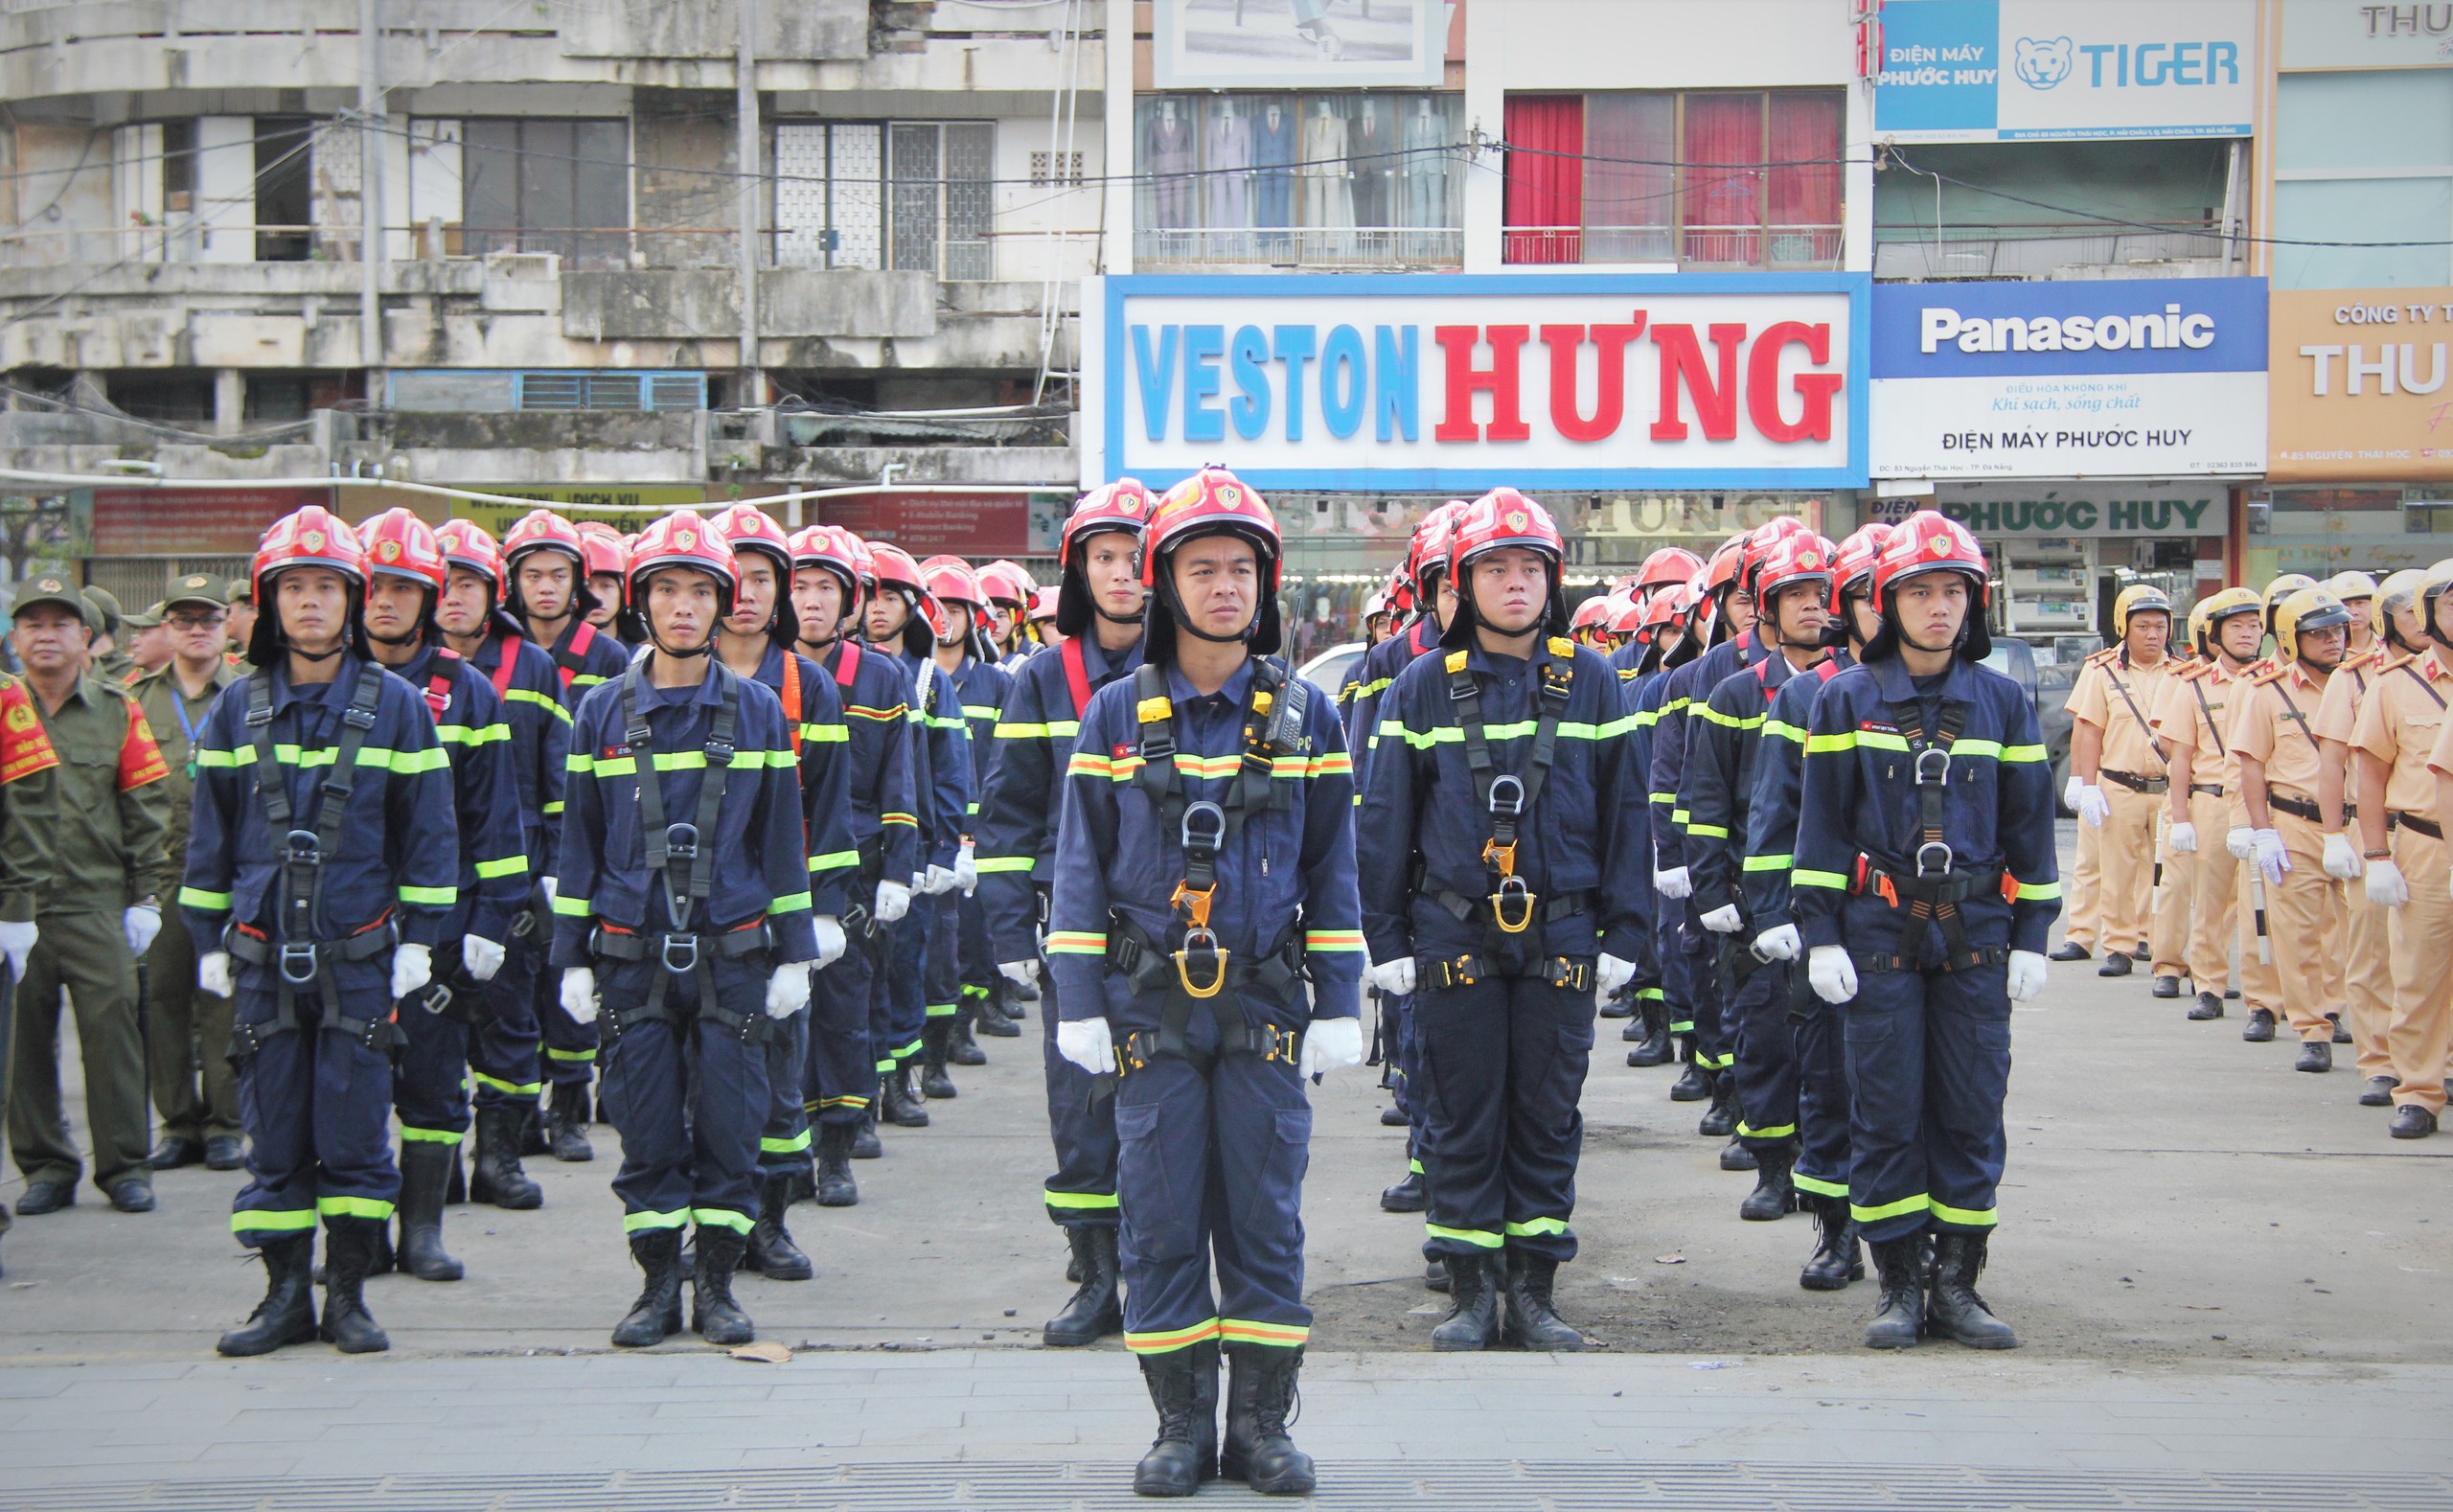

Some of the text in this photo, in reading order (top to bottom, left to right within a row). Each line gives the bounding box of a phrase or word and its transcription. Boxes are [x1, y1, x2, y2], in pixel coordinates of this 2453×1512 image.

[1889, 43, 1984, 65] ĐIỆN MÁY
[2079, 41, 2238, 87] TIGER
[1876, 67, 1998, 86] PHƯỚC HUY
[2334, 302, 2398, 324] CÔNG
[2406, 305, 2435, 323] TY
[1921, 303, 2215, 354] Panasonic
[1132, 309, 1842, 444] VESTON HƯNG
[2300, 343, 2446, 396] THU
[1992, 393, 2142, 413] Khí sạch, sống chất
[1942, 424, 2192, 453] ĐIỆN MÁY PHƯỚC HUY
[1870, 498, 1921, 515] ĐIỆN
[1941, 492, 2211, 531] PHƯỚC HUY
